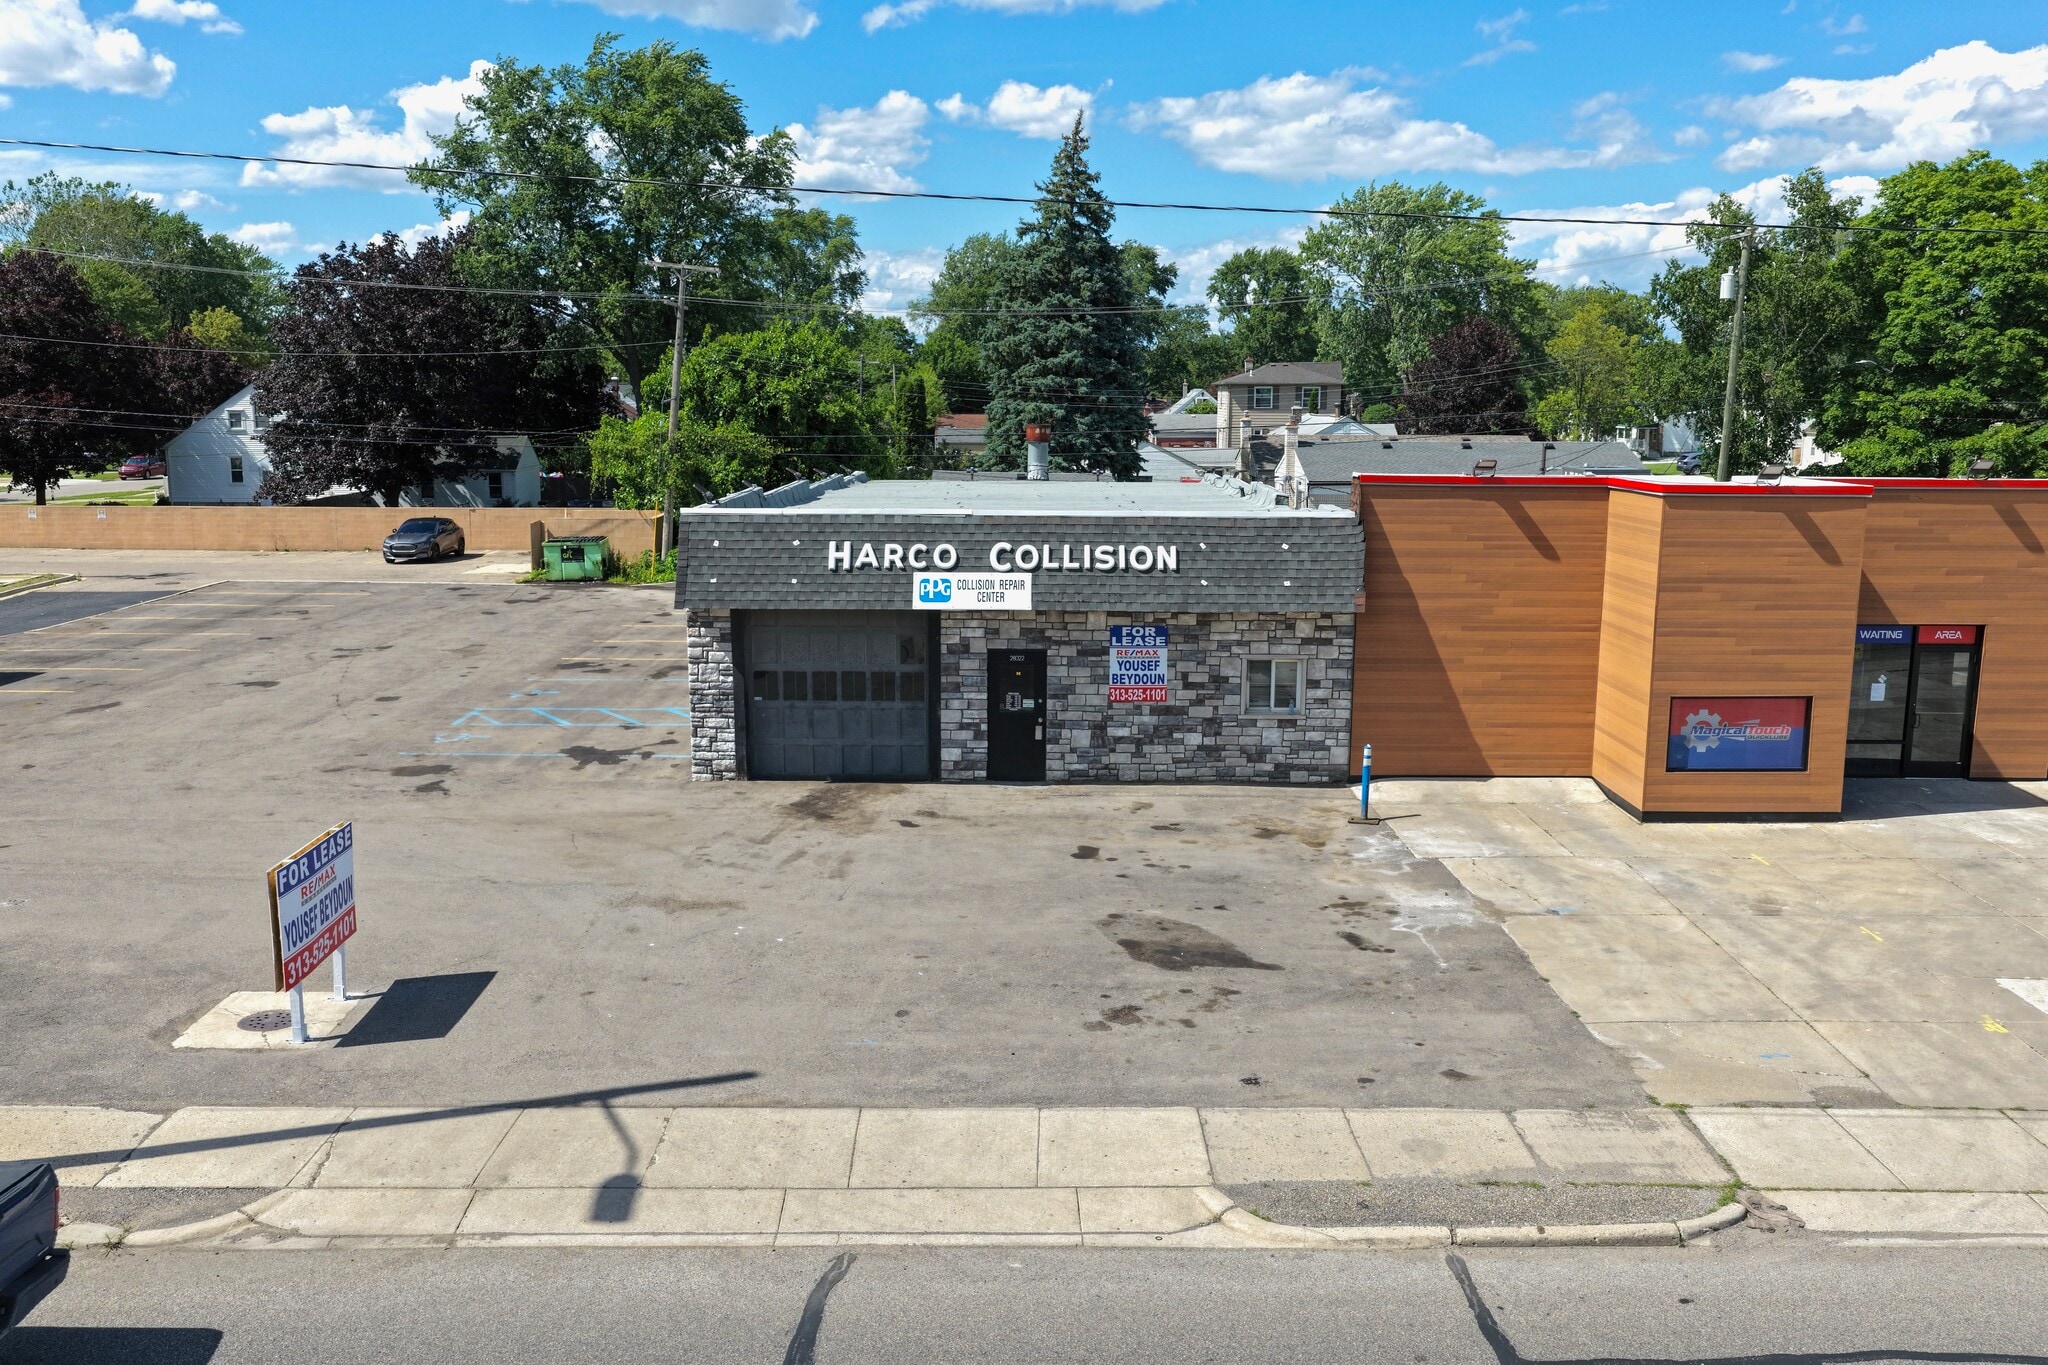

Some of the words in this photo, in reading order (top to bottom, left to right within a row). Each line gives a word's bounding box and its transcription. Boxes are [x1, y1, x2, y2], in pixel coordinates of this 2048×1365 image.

[828, 541, 958, 571] HARCO
[989, 541, 1179, 572] COLLISION
[920, 579, 951, 599] PPG
[957, 579, 995, 590] COLLISION
[999, 579, 1026, 590] REPAIR
[977, 592, 1005, 603] CENTER
[1122, 627, 1156, 637] FOR
[1860, 630, 1903, 639] WAITING
[1935, 630, 1962, 639] AREA
[1111, 637, 1166, 646] LEASE
[1117, 660, 1160, 671] YOUSEF
[1112, 674, 1165, 684] BEYDOUN
[279, 855, 310, 893] FOR
[314, 825, 352, 868] LEASE
[301, 863, 336, 899] RE/MAX
[284, 904, 318, 952] YOUSEF
[320, 875, 353, 926] BEYDOUN
[288, 910, 355, 984] 313-525-1101
